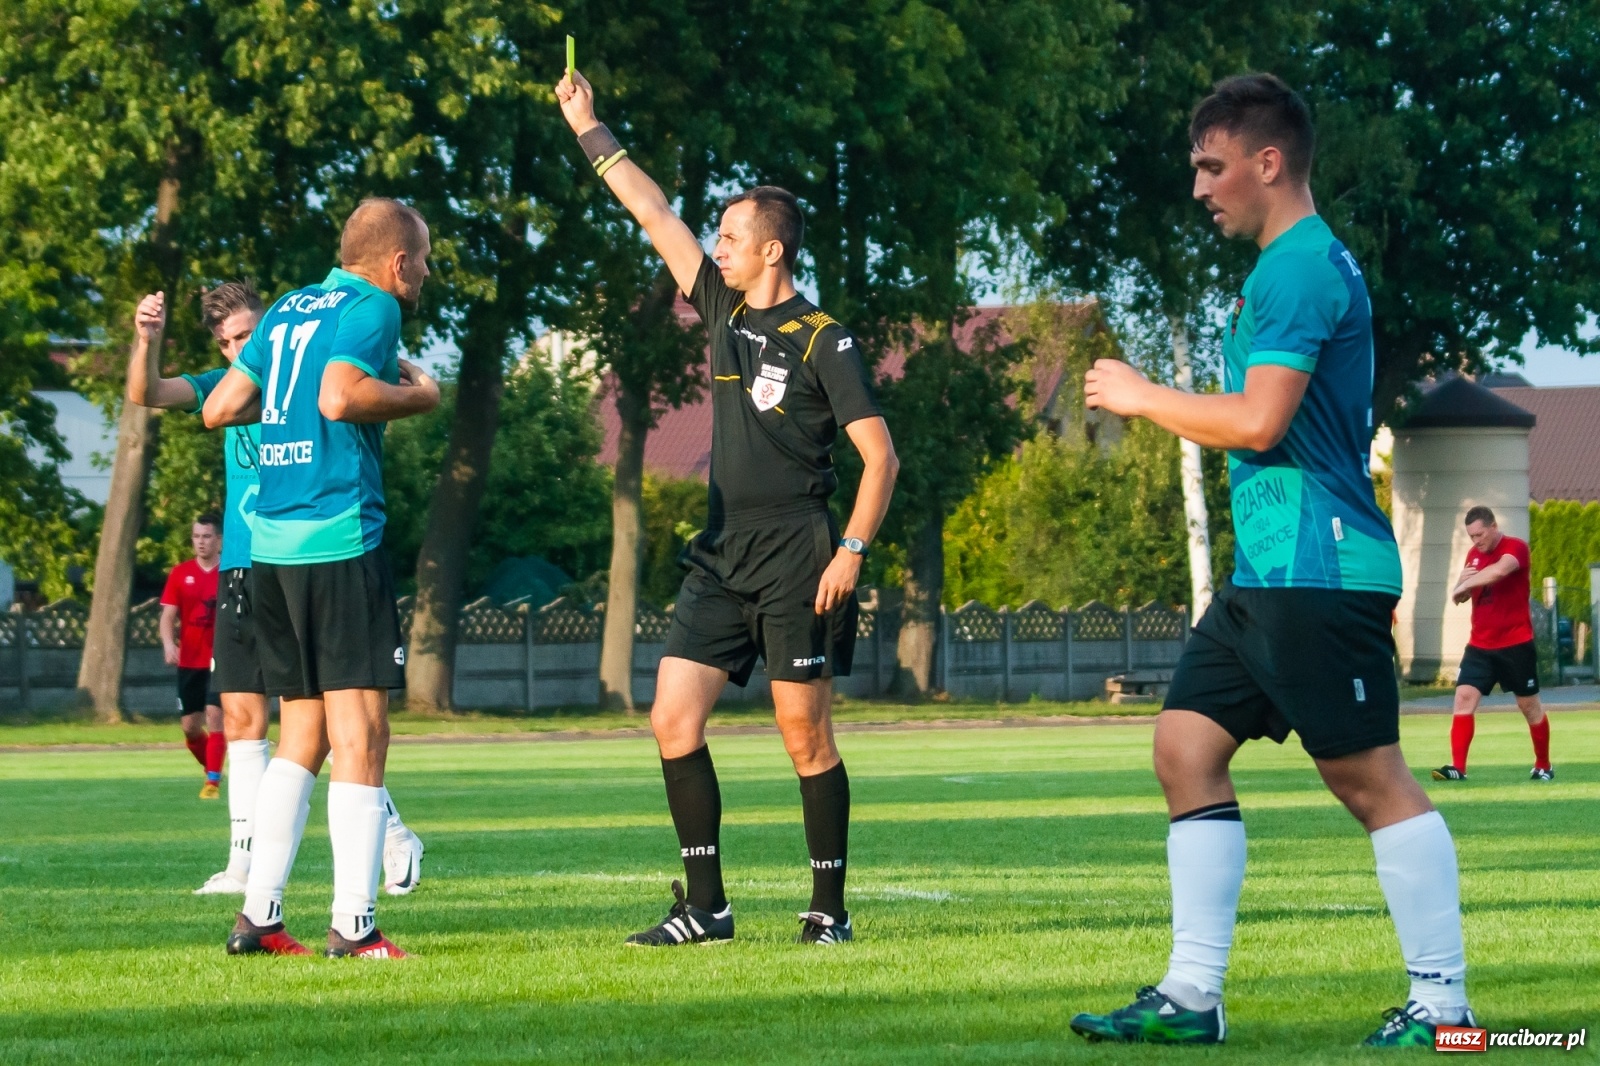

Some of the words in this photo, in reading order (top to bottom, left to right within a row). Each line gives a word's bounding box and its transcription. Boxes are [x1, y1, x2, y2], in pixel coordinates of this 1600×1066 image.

[262, 319, 321, 424] 17
[1235, 476, 1287, 526] CZARNI
[1247, 524, 1296, 560] GORZYCE
[1252, 516, 1271, 534] 1924
